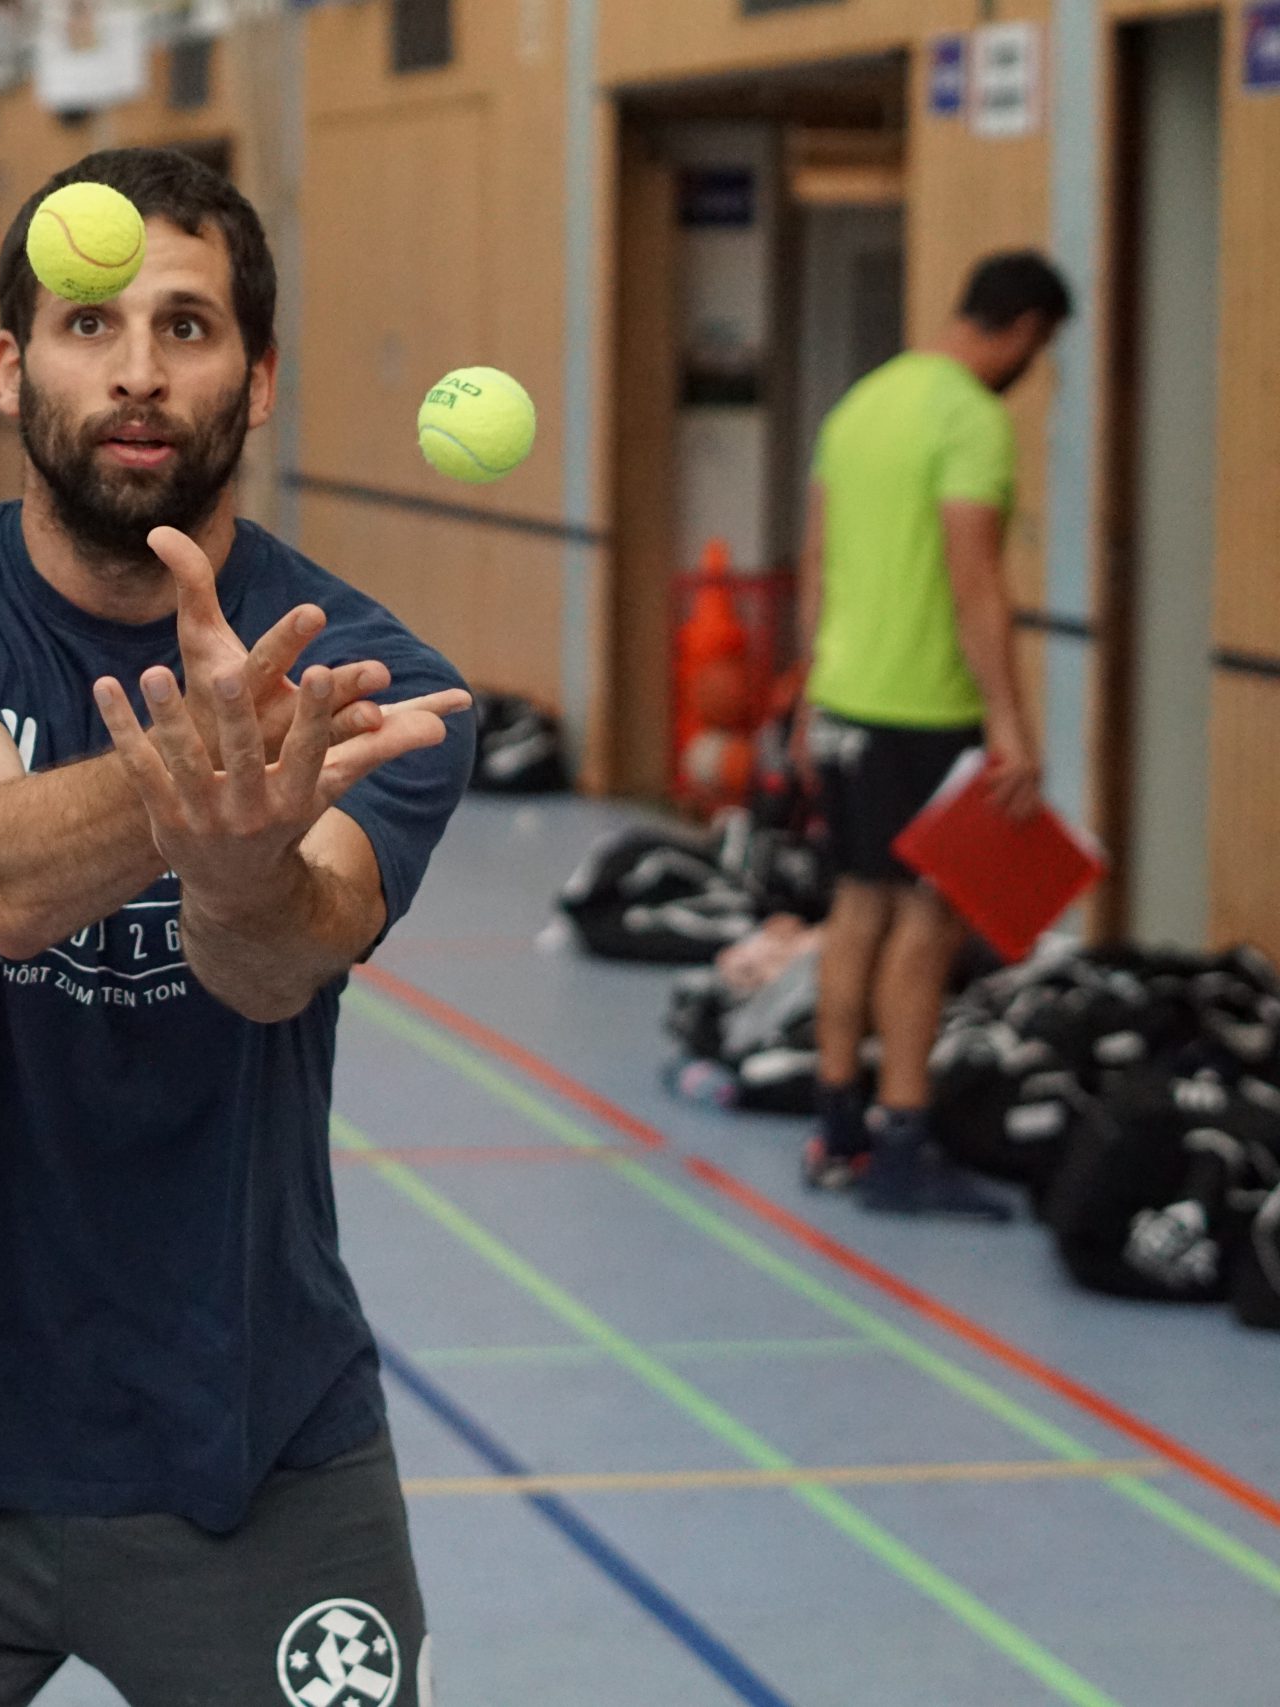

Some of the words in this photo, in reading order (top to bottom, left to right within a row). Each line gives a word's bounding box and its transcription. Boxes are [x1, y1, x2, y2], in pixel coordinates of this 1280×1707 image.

[2, 962, 52, 985] HÖRT
[55, 971, 94, 1006] ZUM
[143, 980, 187, 1005] TON
